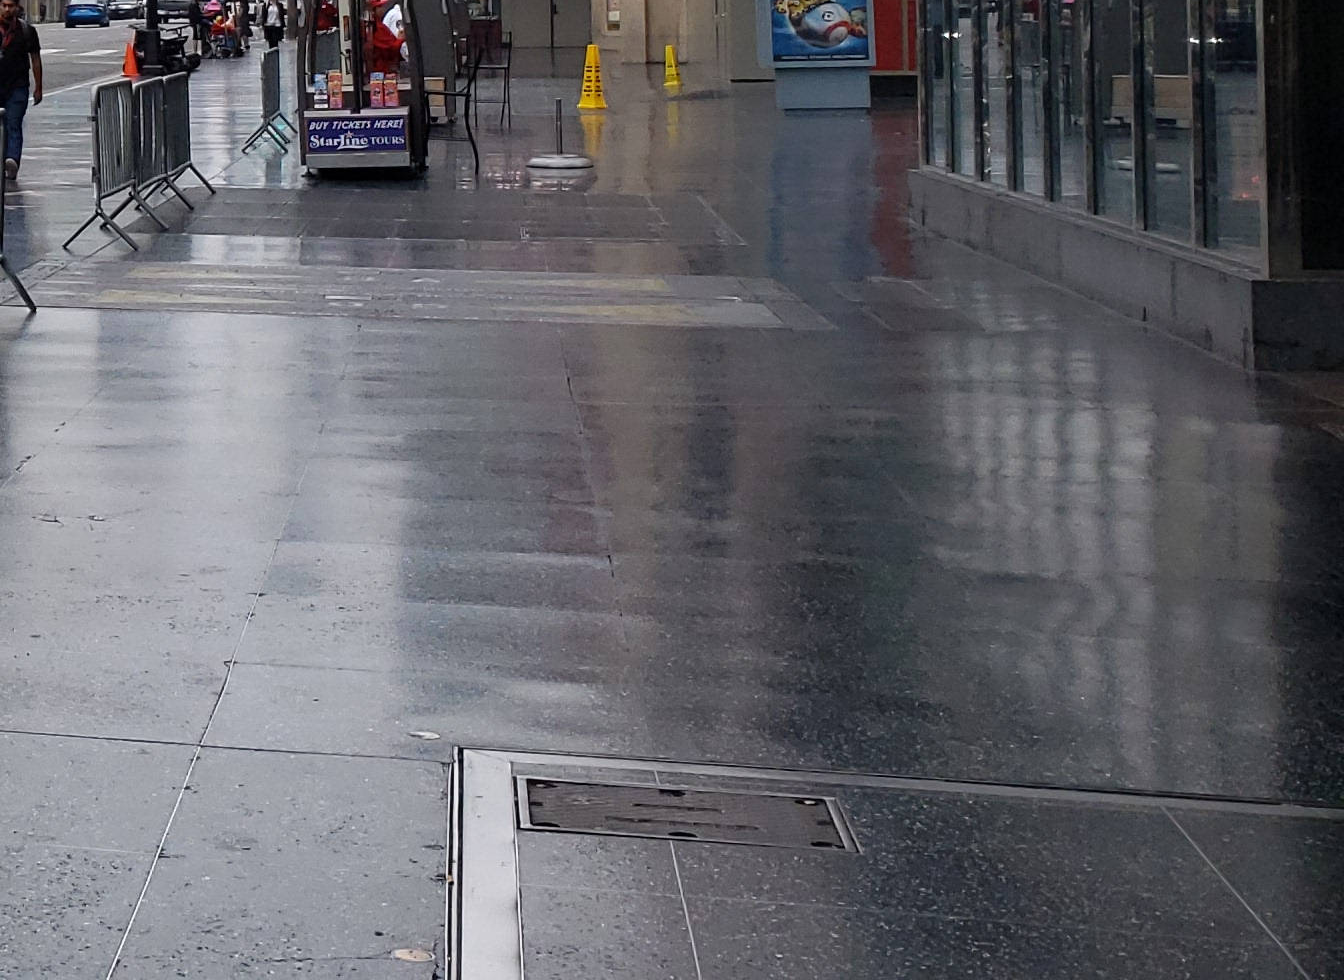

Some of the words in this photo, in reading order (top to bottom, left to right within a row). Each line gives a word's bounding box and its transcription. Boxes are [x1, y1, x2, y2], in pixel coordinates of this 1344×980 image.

[309, 121, 329, 131] BUY
[332, 120, 371, 130] TICKETS
[373, 118, 404, 129] HERE!
[369, 135, 405, 145] TOURS
